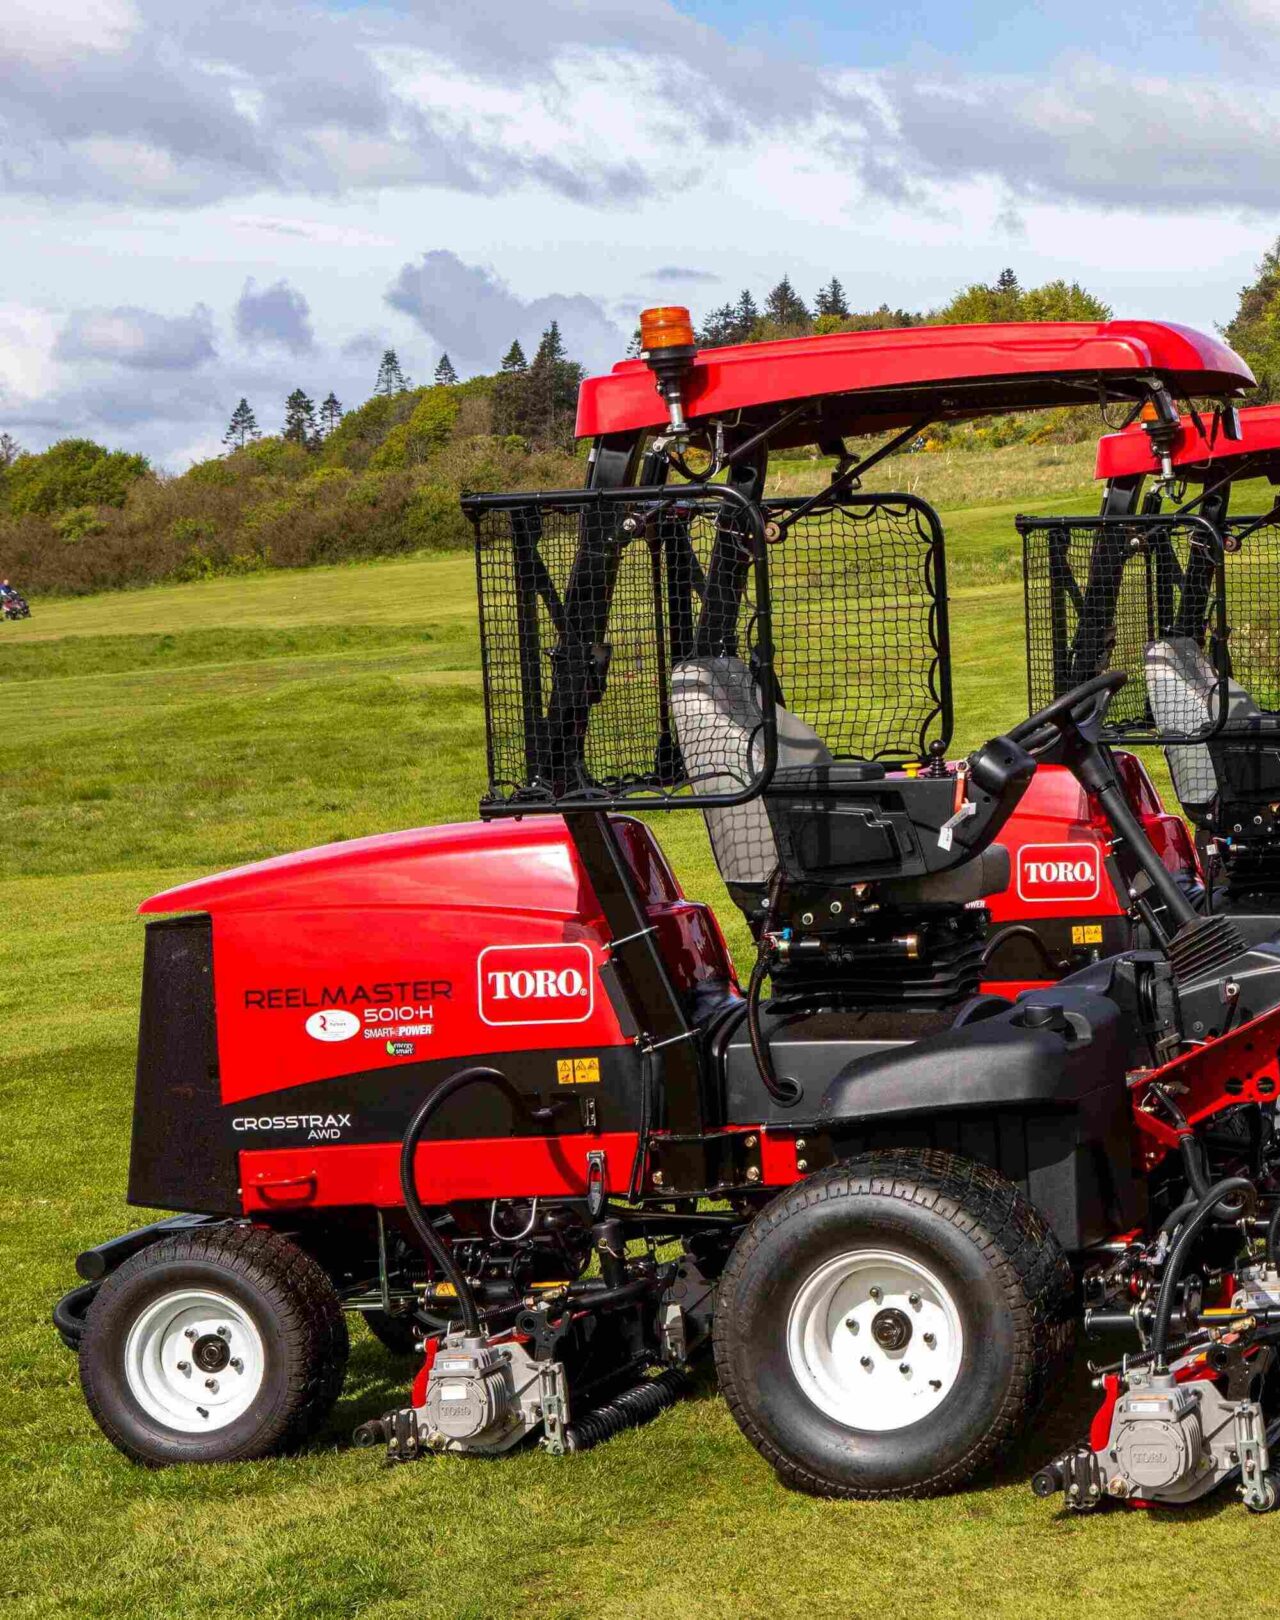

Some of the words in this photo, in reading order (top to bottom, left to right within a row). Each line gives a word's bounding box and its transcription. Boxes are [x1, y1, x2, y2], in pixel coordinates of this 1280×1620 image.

[244, 979, 453, 1009] REELMASTER
[398, 1024, 432, 1036] POWER
[232, 1114, 351, 1131] CROSSTRAX
[307, 1128, 341, 1140] AWD
[441, 1406, 471, 1417] TORO
[1133, 1452, 1168, 1464] TORO
